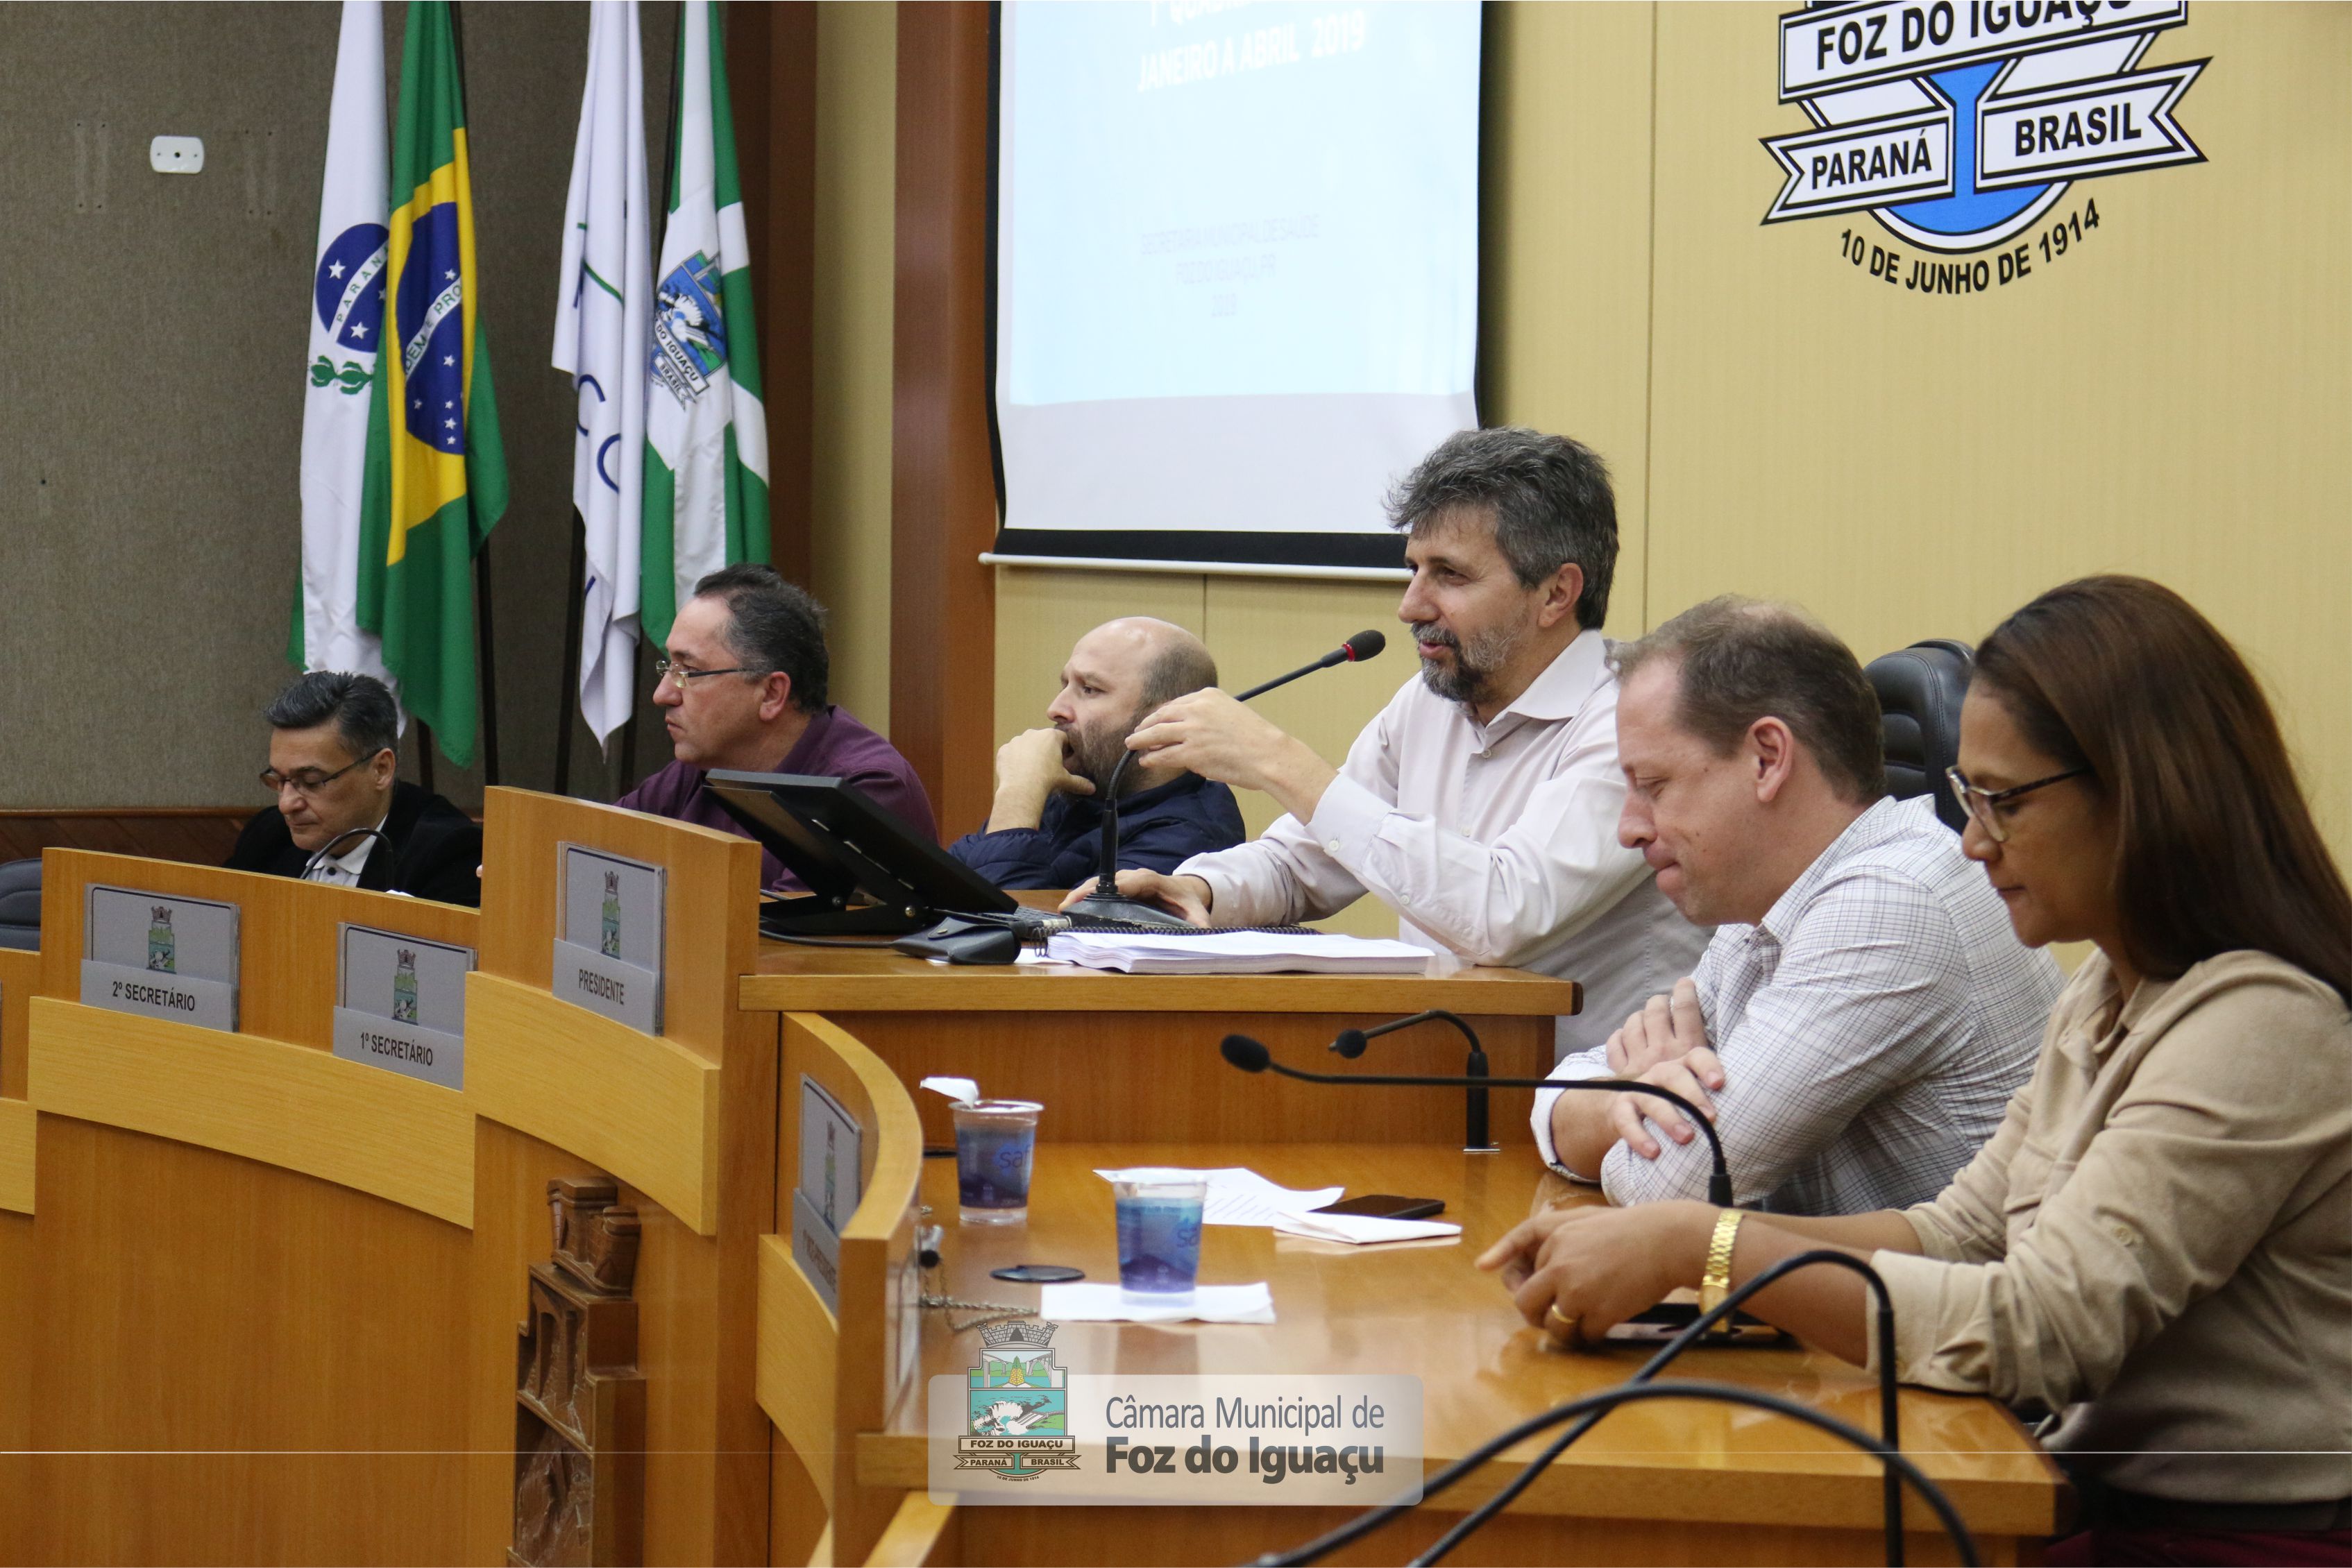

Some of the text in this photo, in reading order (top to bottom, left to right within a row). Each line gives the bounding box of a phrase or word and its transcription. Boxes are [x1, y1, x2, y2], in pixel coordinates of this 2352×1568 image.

[1137, 8, 1367, 92] JANEIRO A ABRIL 2019
[1817, 1, 2133, 70] FOZ DO IGUAÇ
[1813, 128, 1931, 189] PARANÁ
[2015, 103, 2141, 157] BRASIL
[1841, 198, 2100, 294] 10 DE JUNHO DE 1914
[656, 324, 699, 382] DO IGUAÇU
[112, 981, 195, 1012] 2º SECRETÁRIO
[579, 969, 624, 1005] PRESIDENTE
[360, 1032, 433, 1066] 1º SECRETÁRIO
